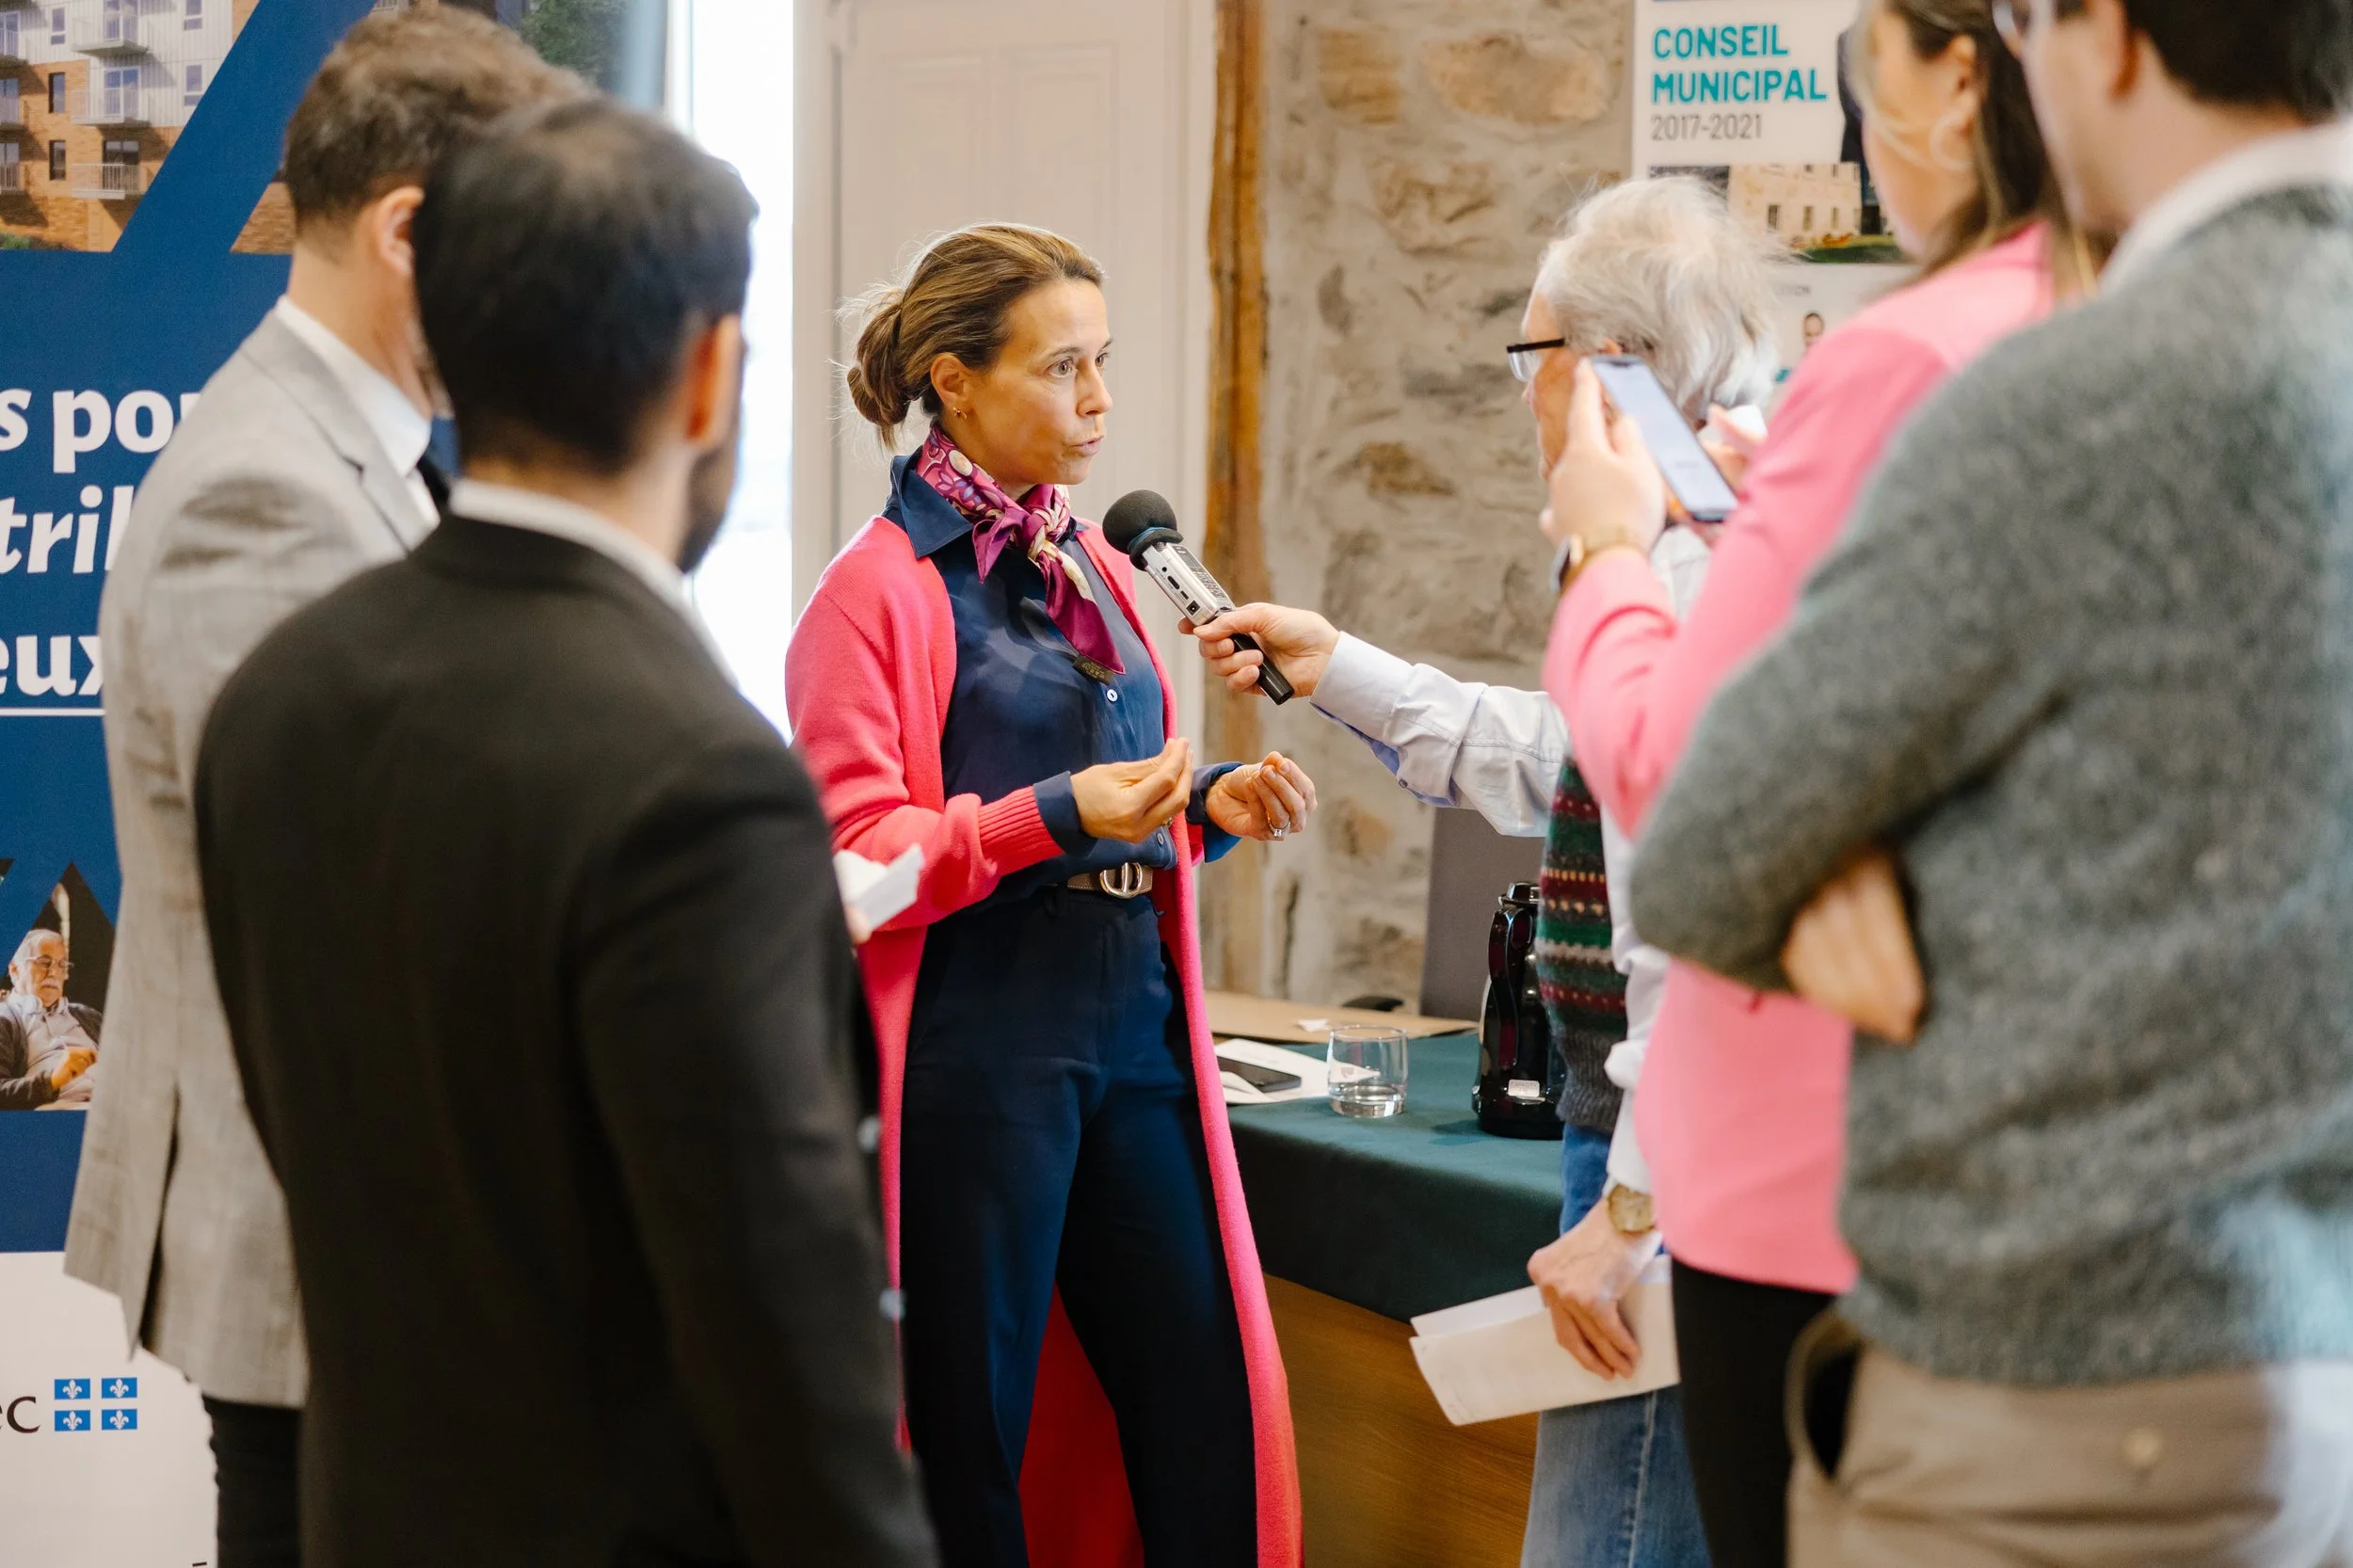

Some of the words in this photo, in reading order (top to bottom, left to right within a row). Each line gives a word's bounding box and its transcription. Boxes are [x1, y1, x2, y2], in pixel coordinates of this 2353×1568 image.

[1654, 24, 1789, 58] CONSEIL
[1653, 69, 1828, 103] MUNICIPAL
[1651, 114, 1763, 140] 2017-2021
[0, 635, 104, 696] ux
